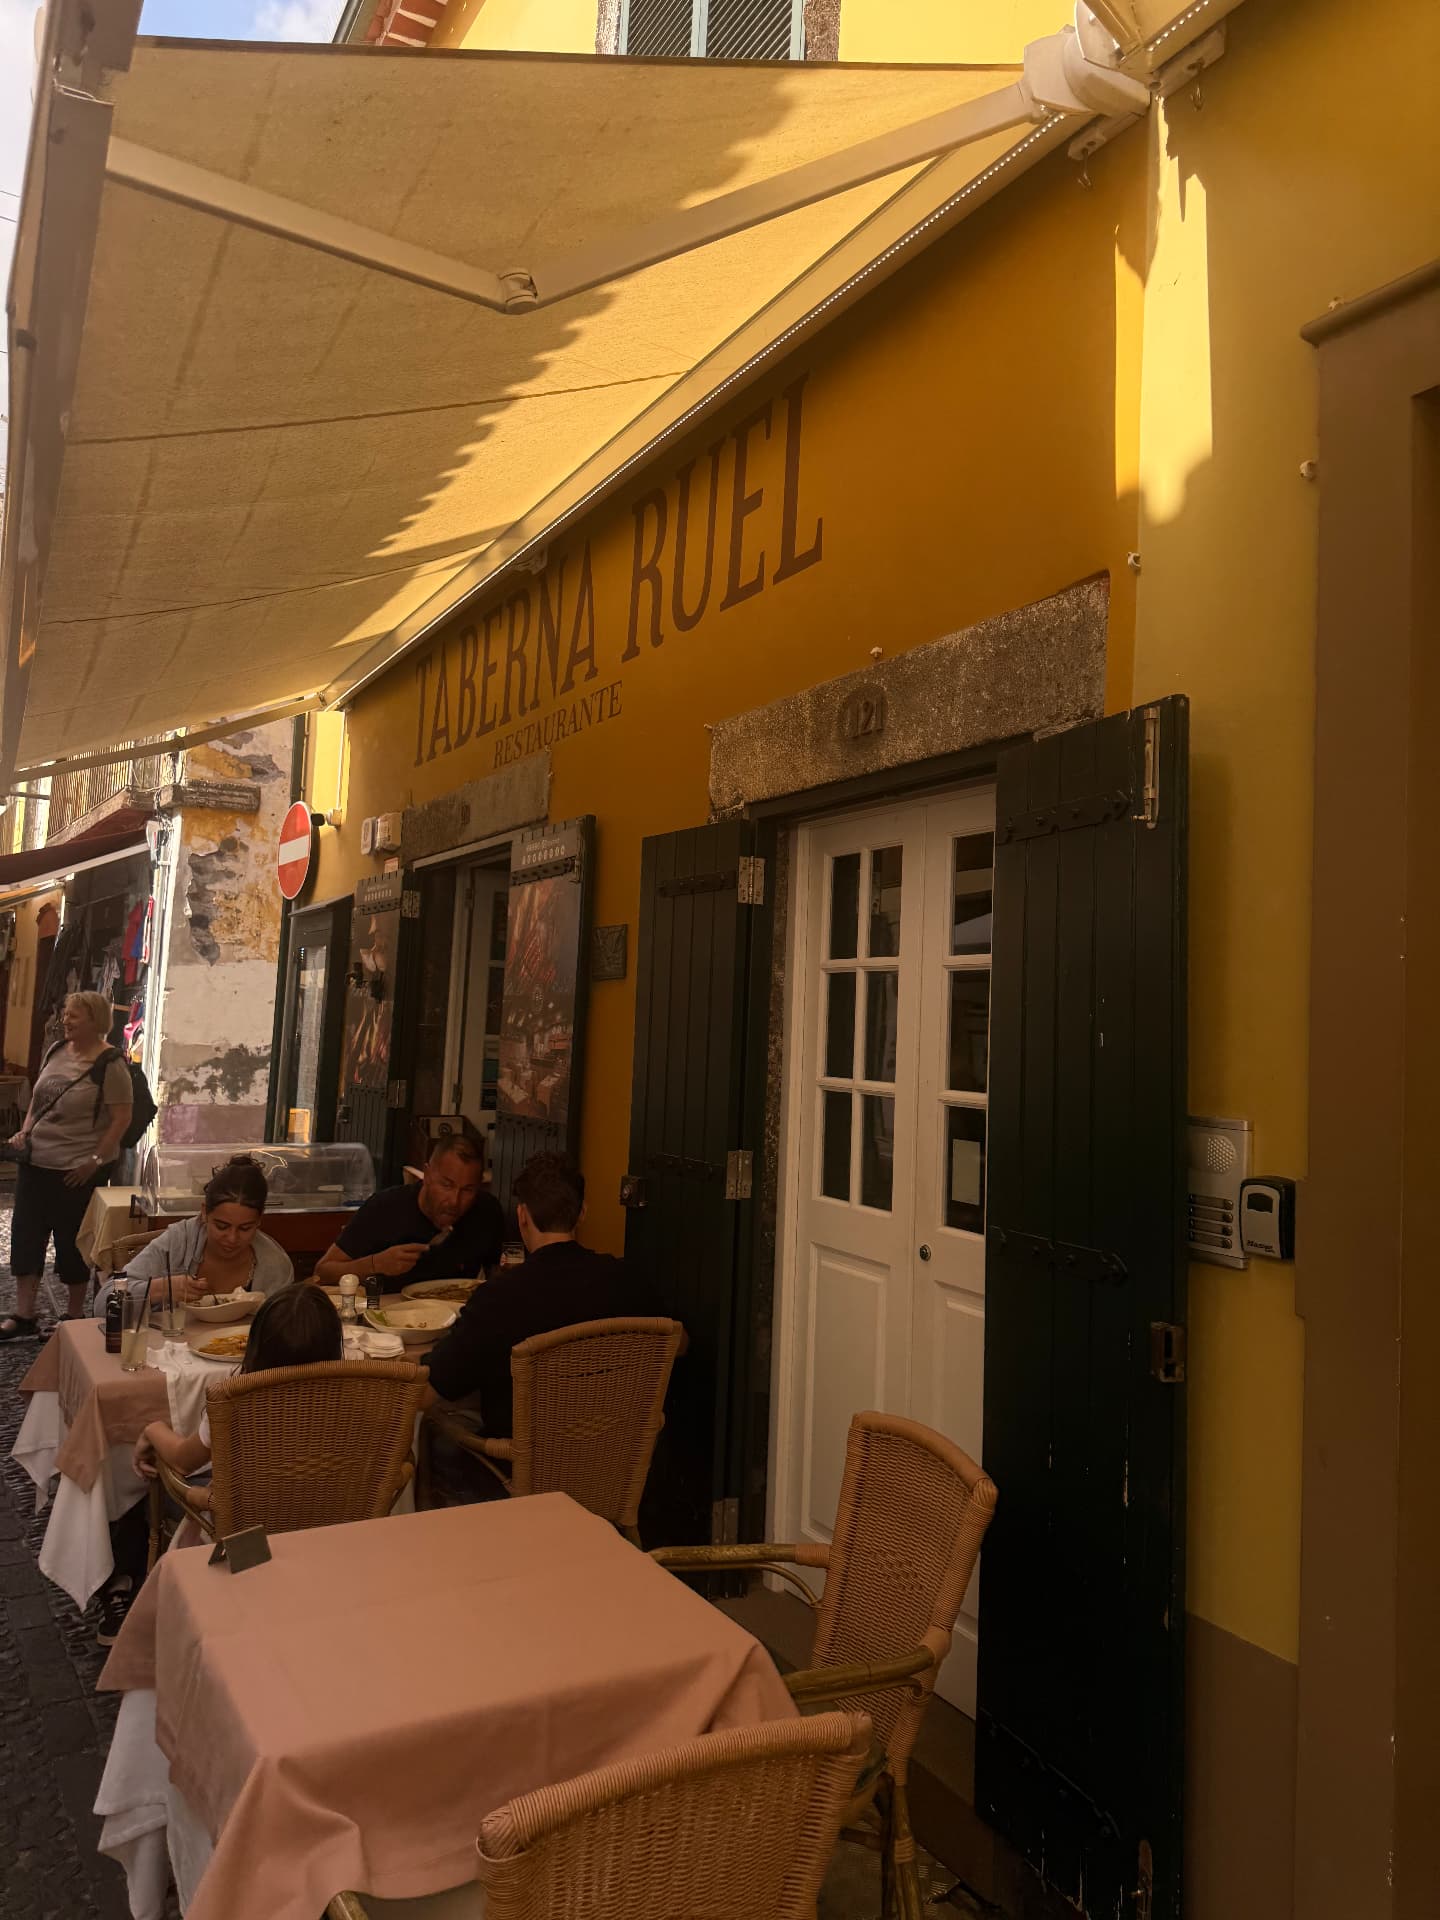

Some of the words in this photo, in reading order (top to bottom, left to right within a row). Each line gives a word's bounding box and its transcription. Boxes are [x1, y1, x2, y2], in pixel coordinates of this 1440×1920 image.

[414, 538, 599, 768] TABERNA
[621, 371, 823, 663] RUEL
[493, 680, 623, 770] RESTAURANTE
